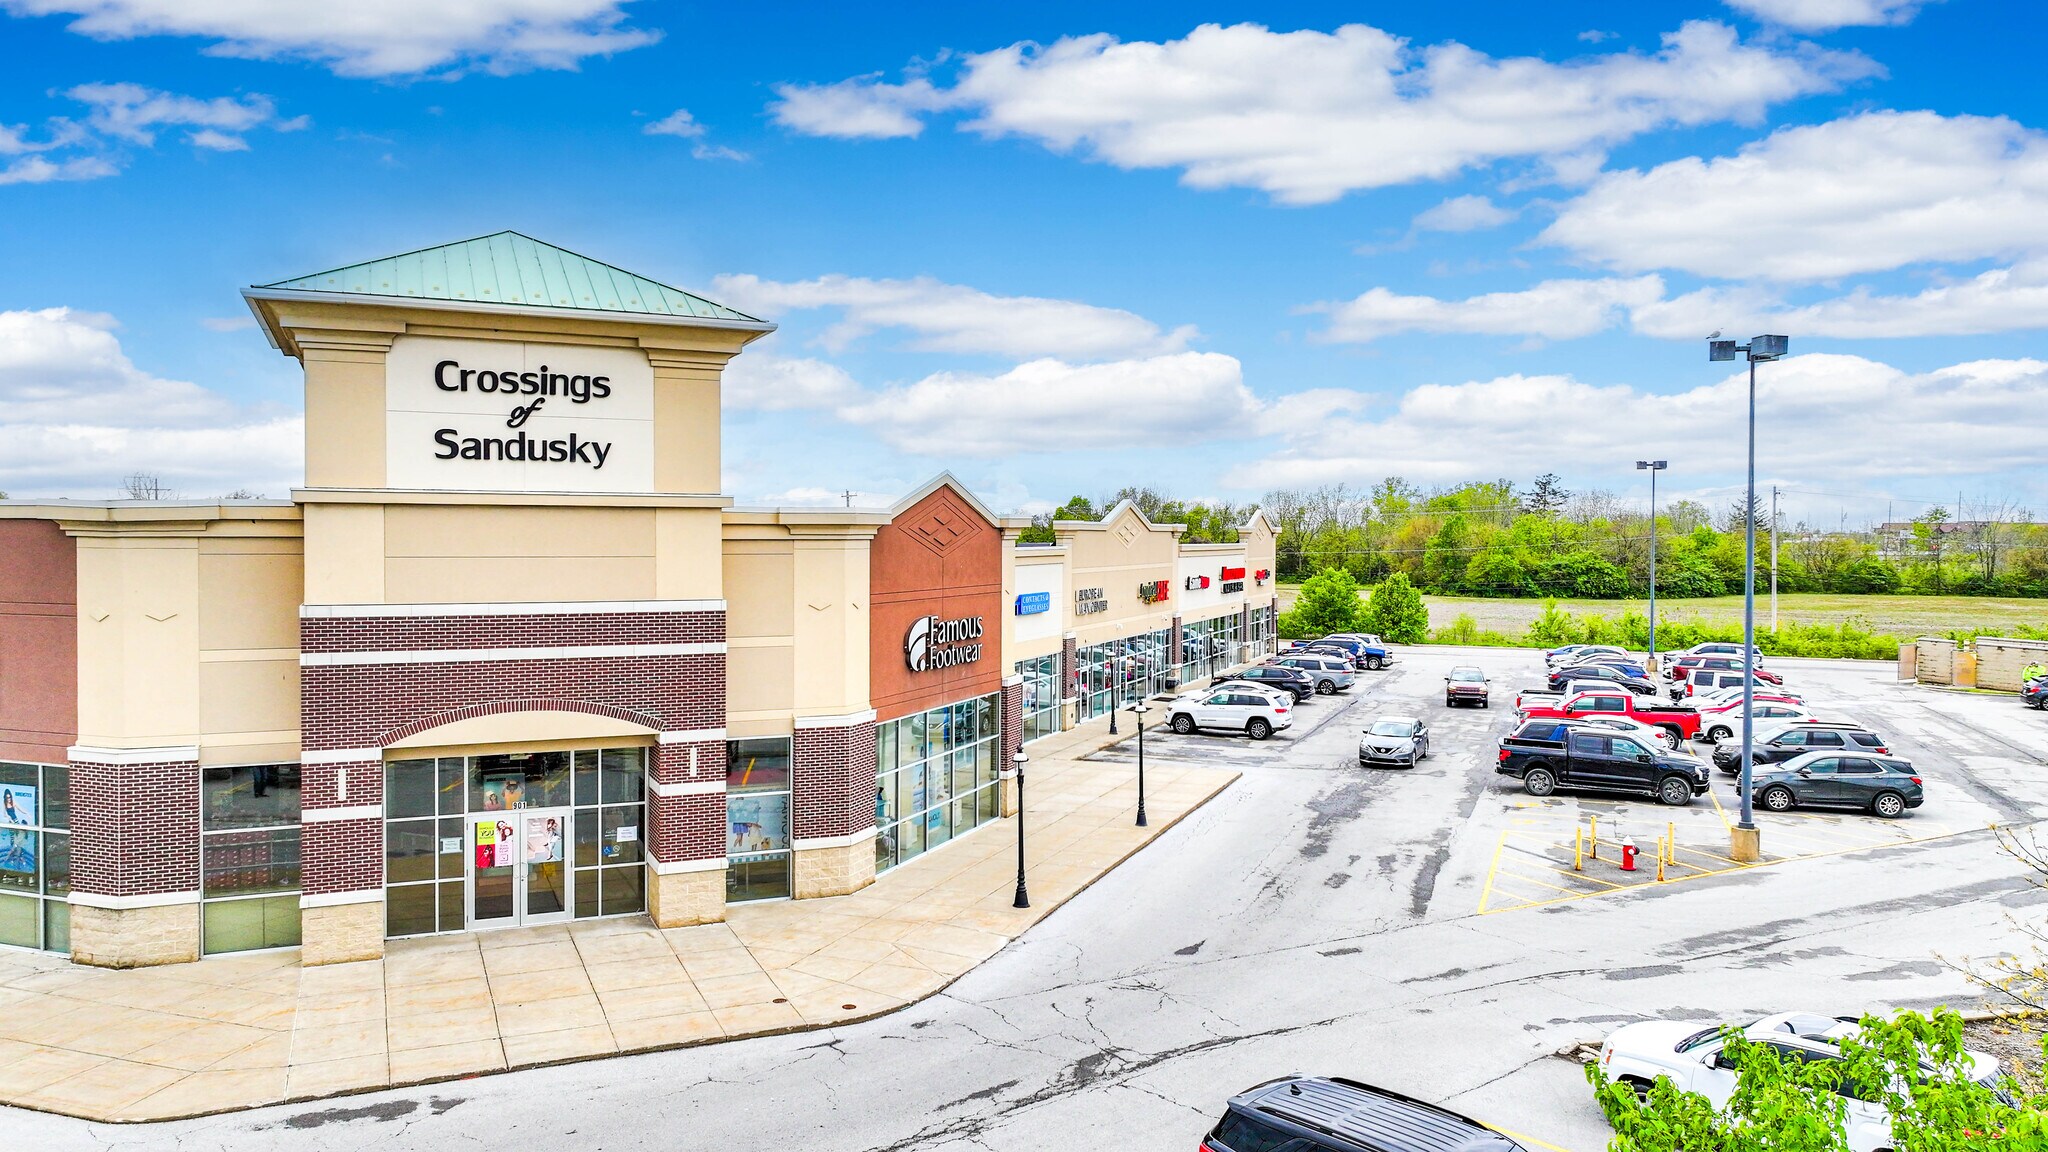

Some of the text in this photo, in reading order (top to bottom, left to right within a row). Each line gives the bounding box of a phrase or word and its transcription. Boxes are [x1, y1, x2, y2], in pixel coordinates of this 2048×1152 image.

[434, 360, 612, 404] Crossings
[506, 397, 546, 428] of
[434, 428, 612, 470] Sandusky
[929, 615, 984, 645] Famous
[929, 643, 983, 670] Footwear
[512, 801, 527, 809] 901
